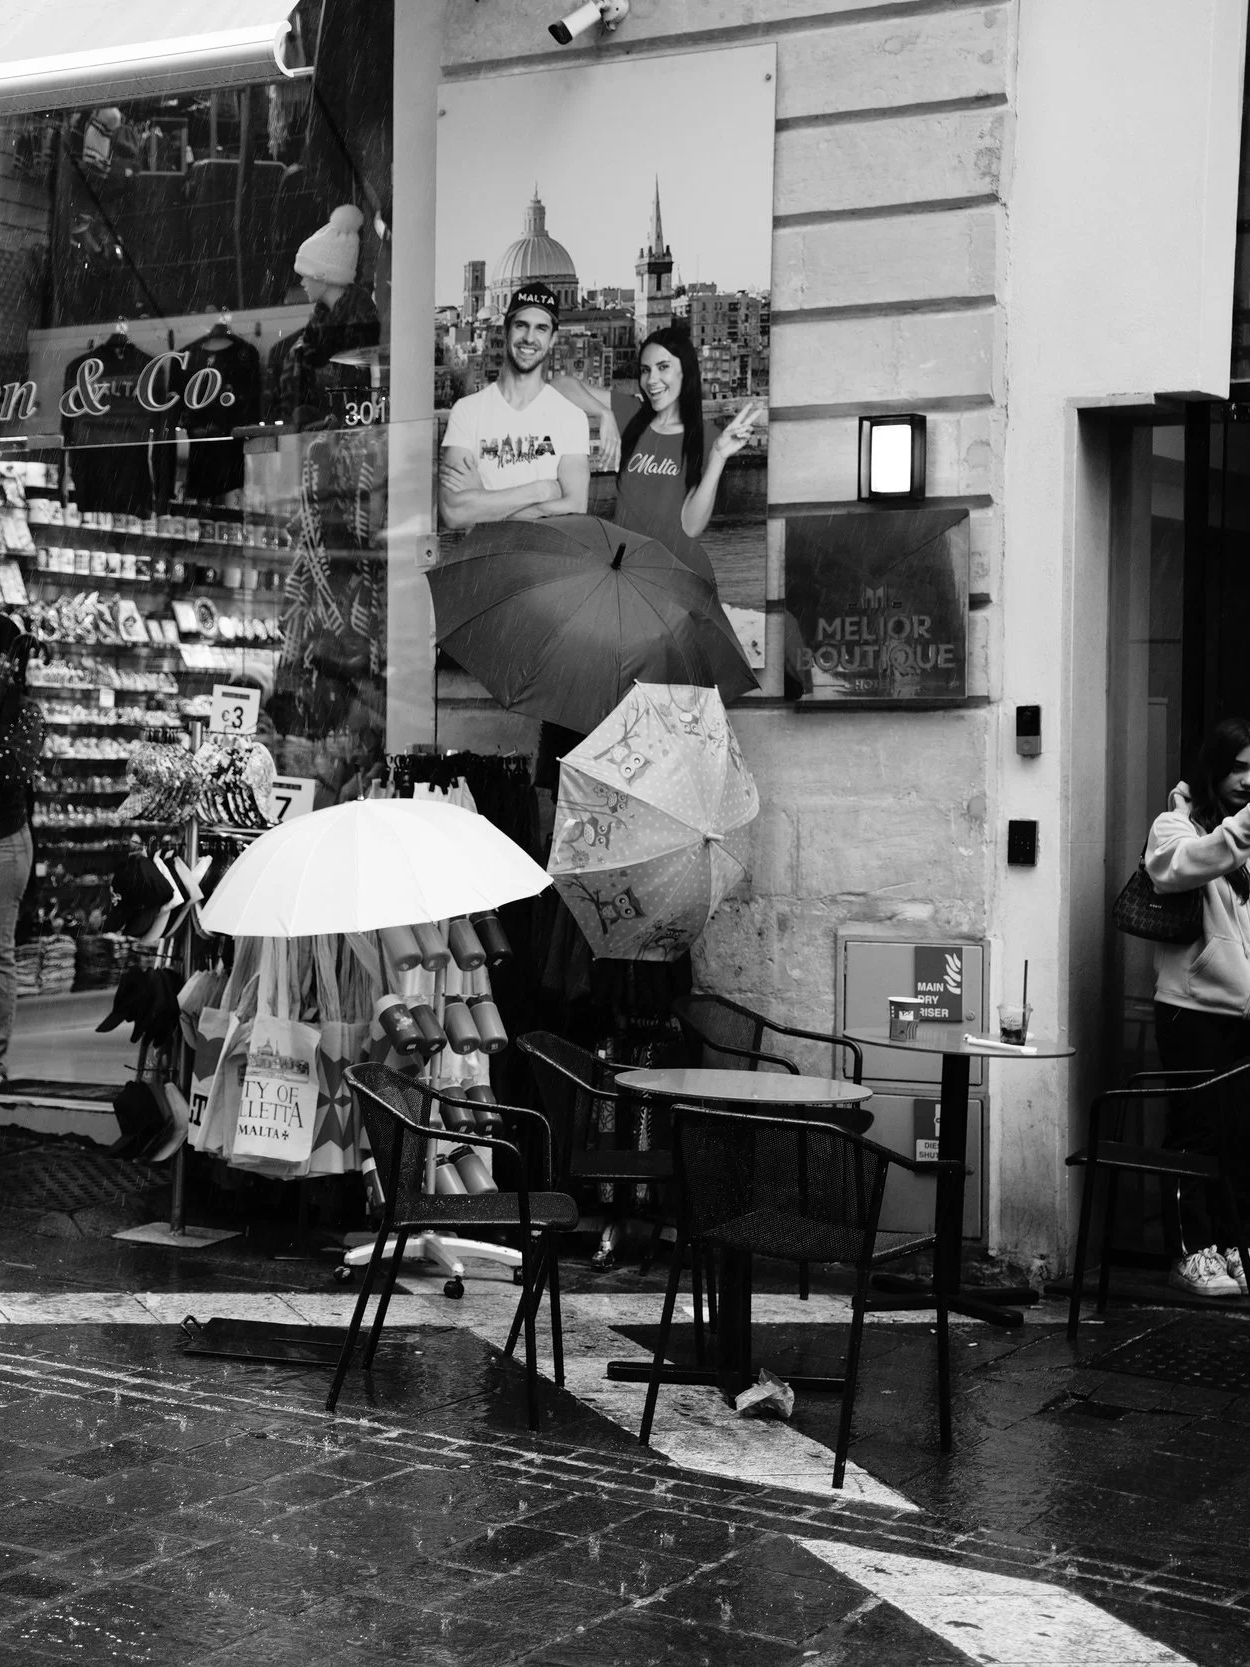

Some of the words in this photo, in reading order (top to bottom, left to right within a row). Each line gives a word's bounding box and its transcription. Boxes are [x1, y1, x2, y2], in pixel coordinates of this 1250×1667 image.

[517, 291, 555, 306] MALTA
[58, 357, 111, 418] &
[136, 351, 236, 412] Co.
[345, 401, 385, 426] 301
[627, 451, 681, 477] Malta
[817, 615, 933, 642] MELIOR
[797, 644, 956, 674] BOUTIQUE
[917, 982, 944, 992] MAIN
[277, 1084, 299, 1104] OF
[238, 1124, 280, 1140] MALTA
[924, 1142, 939, 1150] DIE
